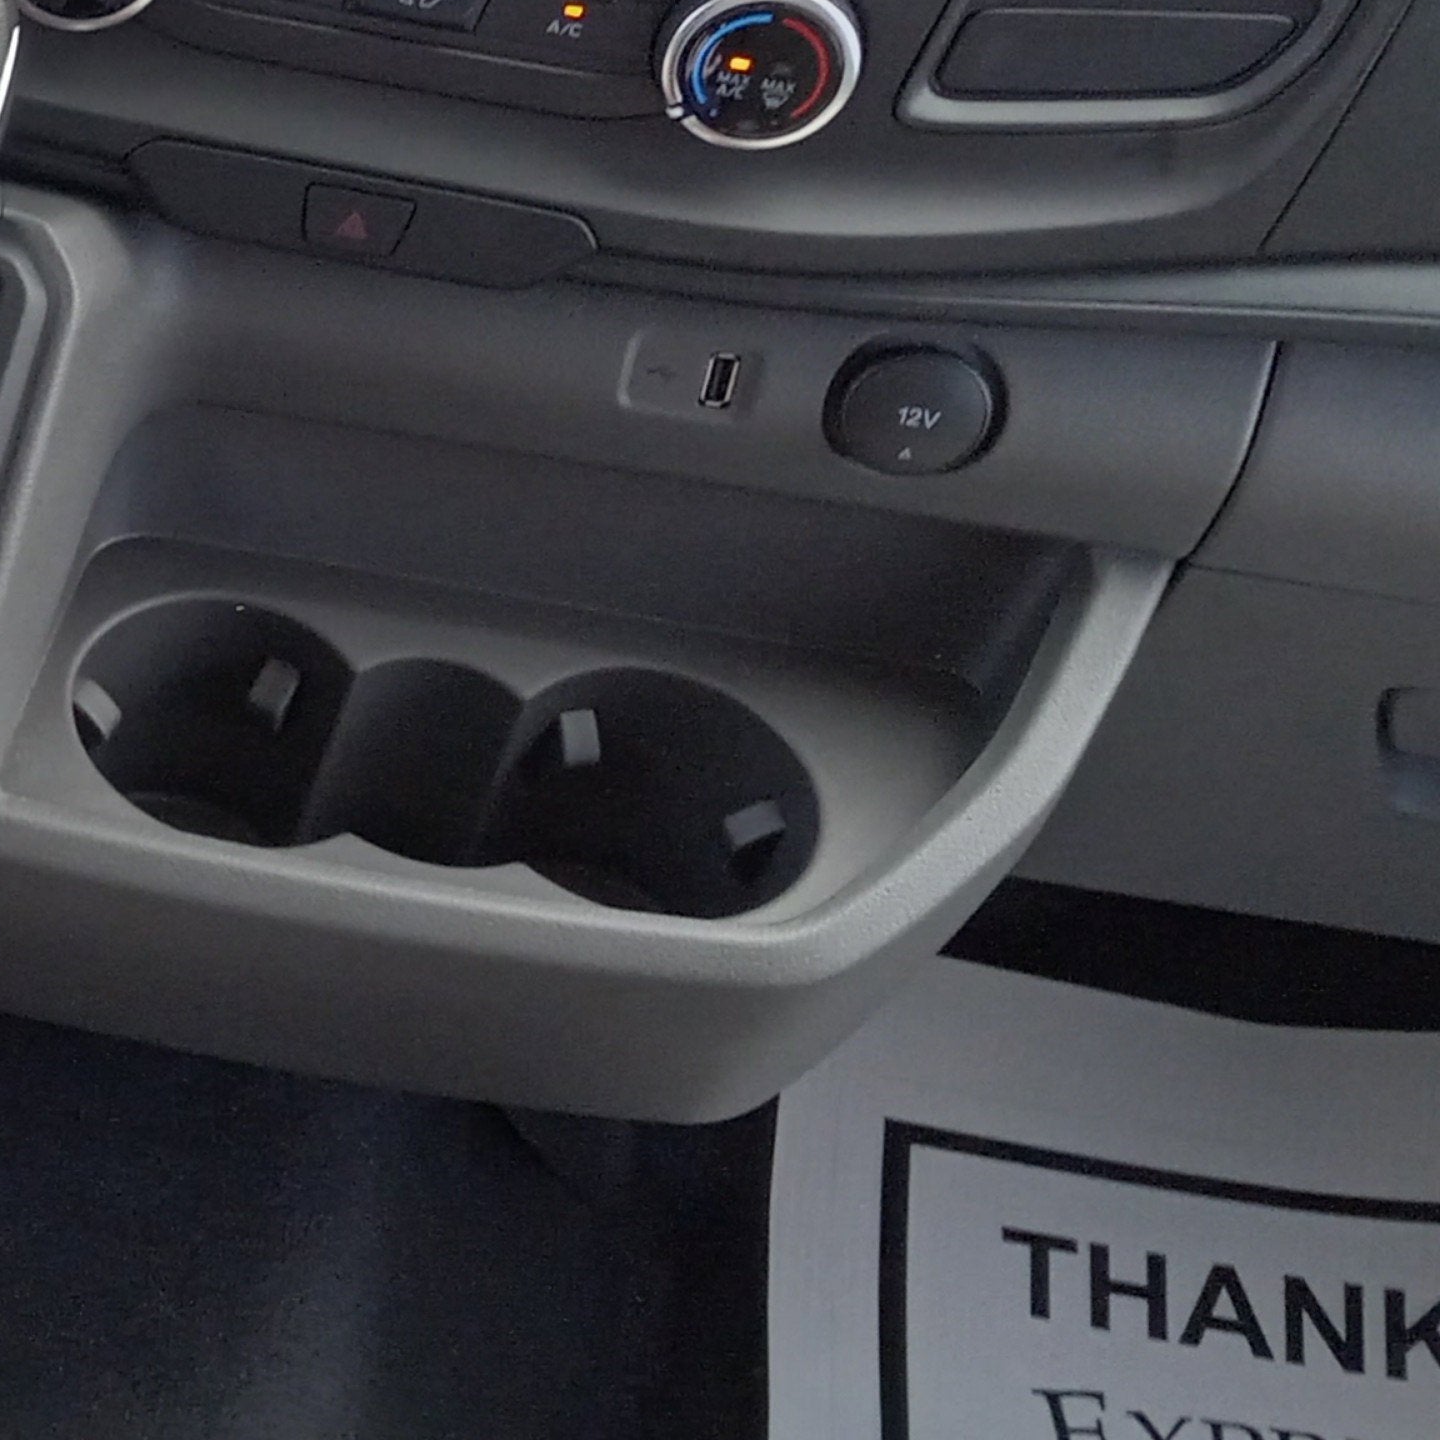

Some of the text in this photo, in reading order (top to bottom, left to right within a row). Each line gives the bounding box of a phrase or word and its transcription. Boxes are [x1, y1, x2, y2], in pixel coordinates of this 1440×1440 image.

[546, 19, 584, 39] A/C
[898, 405, 942, 431] 12V
[1001, 1226, 1440, 1381] THANK
